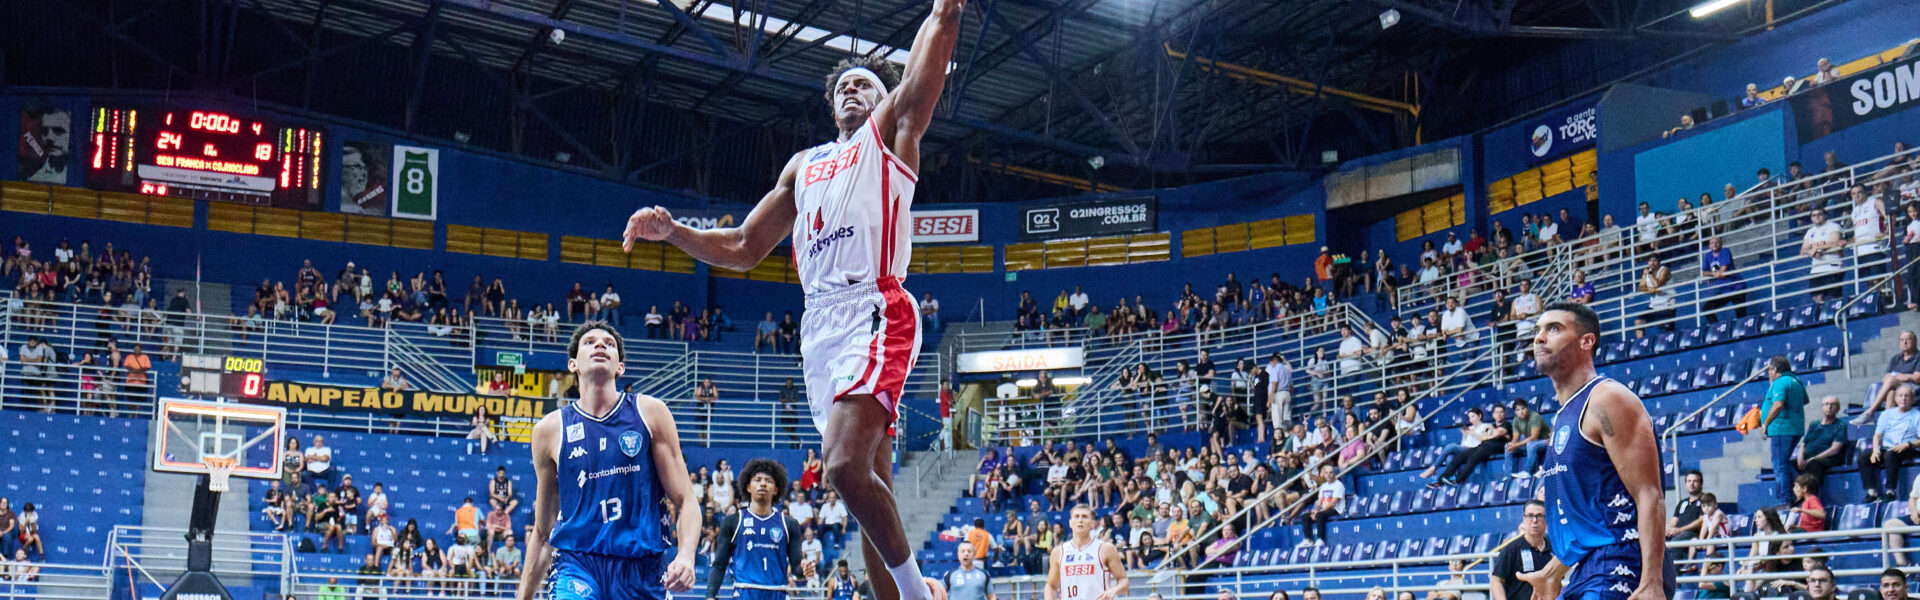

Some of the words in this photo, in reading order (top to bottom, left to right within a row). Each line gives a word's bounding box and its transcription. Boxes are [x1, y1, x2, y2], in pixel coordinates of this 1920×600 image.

[252, 122, 262, 136] 4
[157, 132, 182, 150] 24
[255, 143, 272, 161] 18
[808, 146, 858, 184] SESI
[407, 167, 424, 194] 8
[1034, 214, 1050, 225] Q2
[1069, 204, 1147, 218] Q2INGRESSOS
[1101, 213, 1147, 226] .COM.BR
[918, 217, 967, 235] SESI
[225, 356, 262, 373] 00:00
[243, 373, 261, 396] 0
[264, 381, 404, 410] AMPEÃO
[413, 392, 544, 419] MUNDIAL
[599, 497, 622, 524] 13
[763, 557, 768, 571] 1
[1067, 564, 1092, 576] SESI
[1067, 585, 1078, 599] 10
